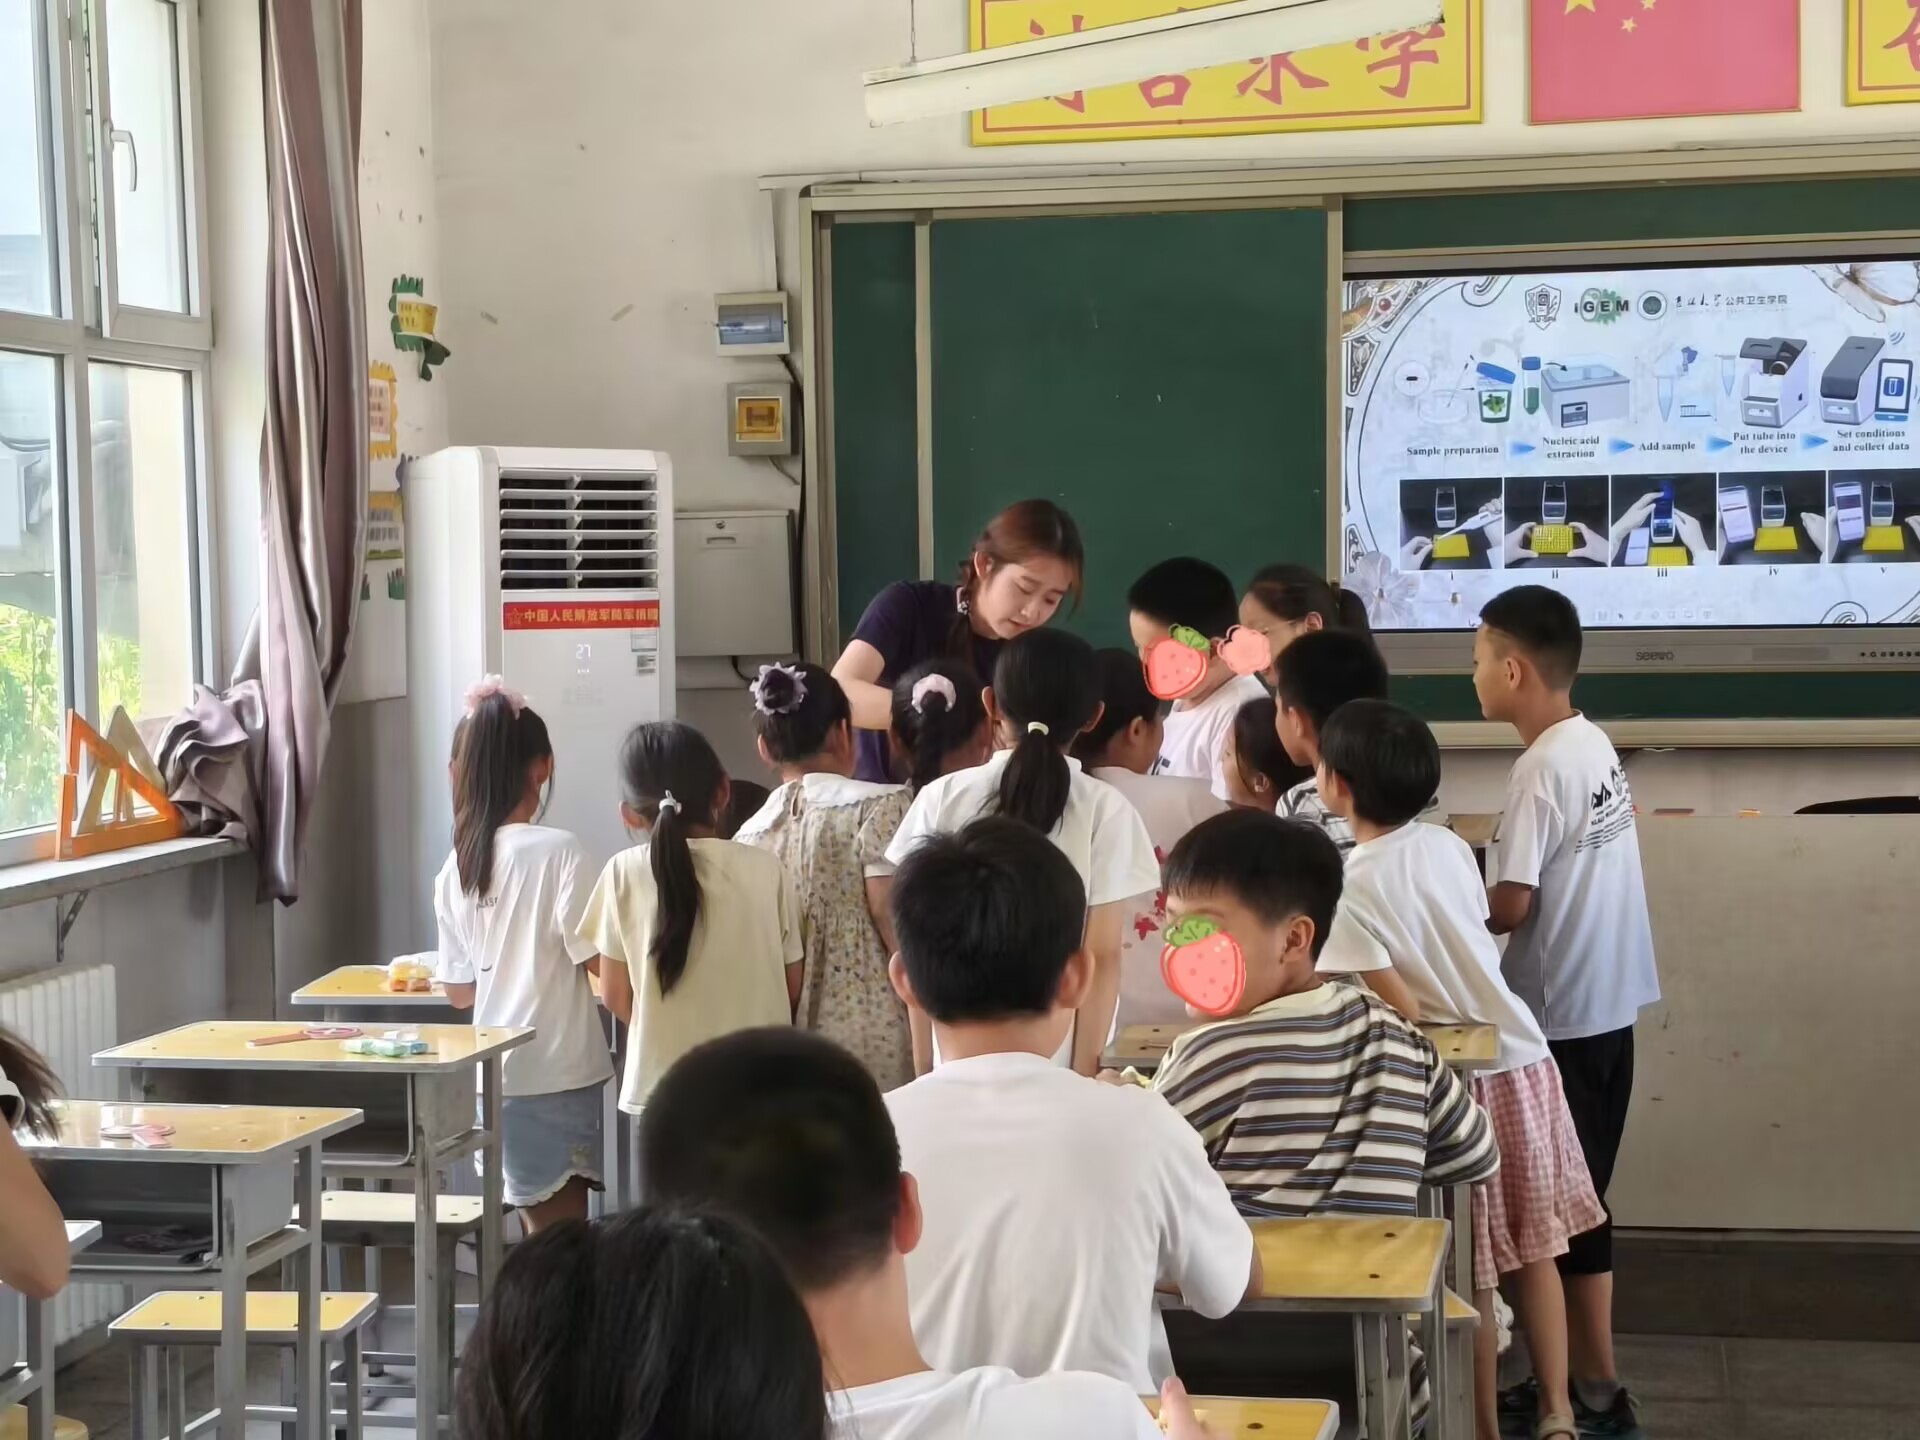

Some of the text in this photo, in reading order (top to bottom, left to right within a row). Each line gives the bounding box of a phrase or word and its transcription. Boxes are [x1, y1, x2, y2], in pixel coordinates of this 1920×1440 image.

[1733, 431, 1796, 441] Put tube into
[1837, 428, 1906, 438] Set conditions
[1542, 435, 1600, 446] Nucleic acid
[1406, 445, 1499, 457] Sample preparation
[1639, 441, 1696, 452] Add sample
[1740, 444, 1788, 454] the device
[1832, 442, 1910, 452] and collect data
[1547, 449, 1595, 459] extraction
[576, 643, 591, 660] 27
